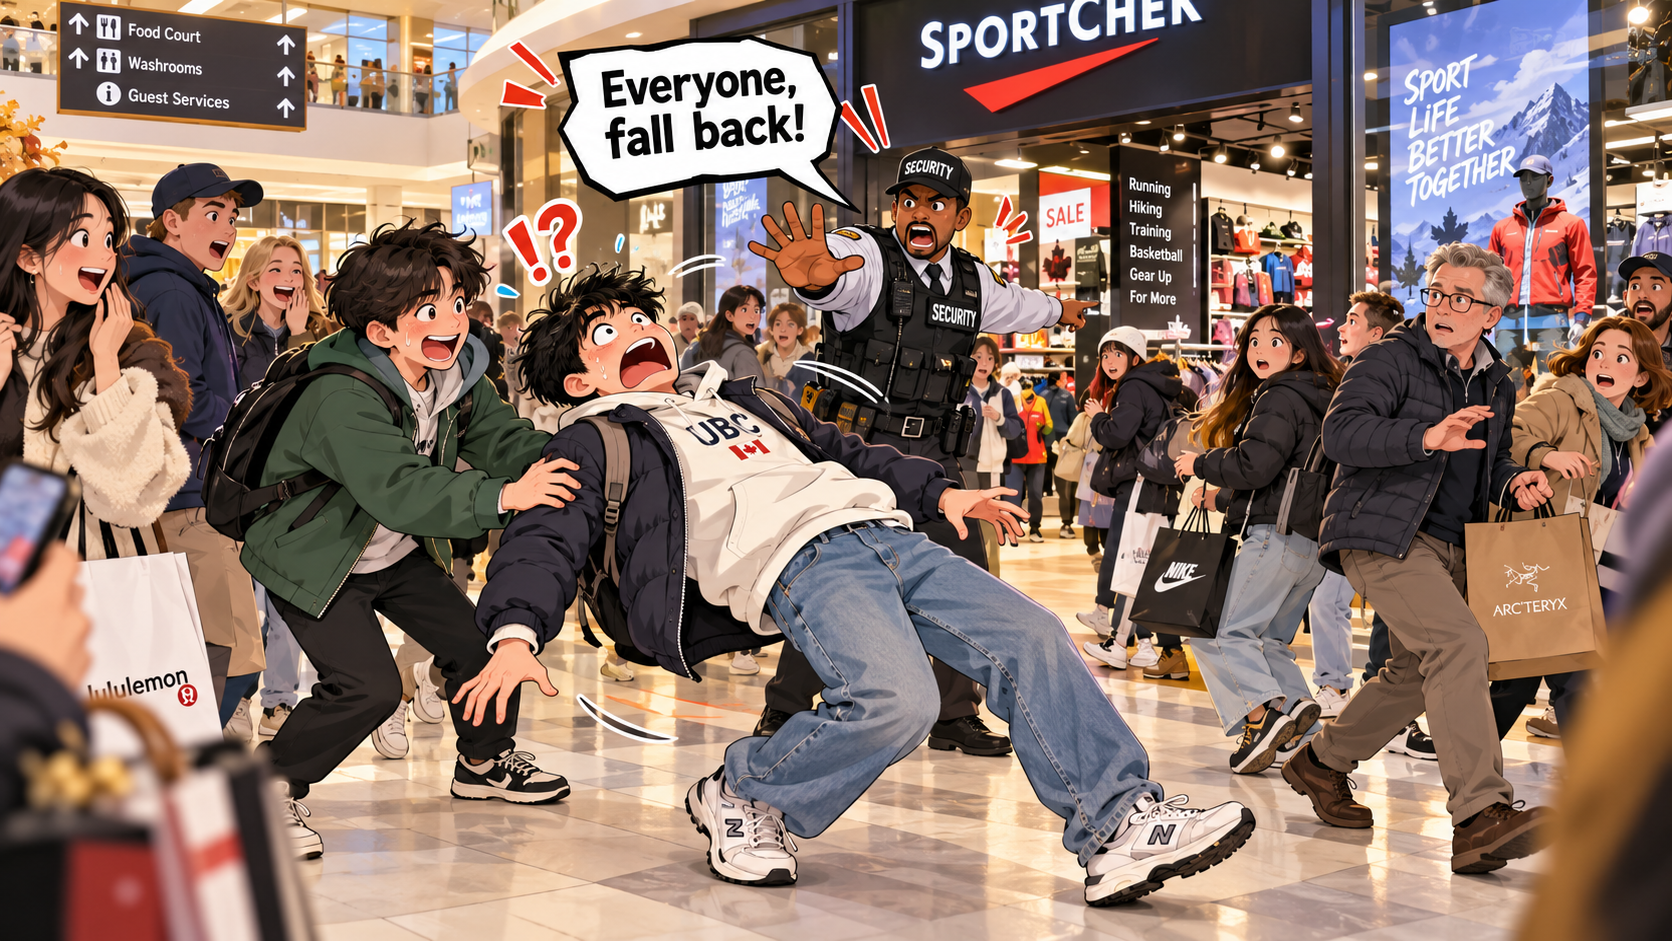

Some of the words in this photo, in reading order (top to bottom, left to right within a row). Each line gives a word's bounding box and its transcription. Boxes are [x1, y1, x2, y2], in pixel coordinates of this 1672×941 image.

[128, 23, 161, 39] Food
[164, 27, 201, 43] Court
[128, 56, 203, 75] Washrooms
[1404, 53, 1478, 105] SPORT
[128, 88, 169, 104] Guest
[172, 92, 230, 109] Services
[1407, 119, 1496, 174] BETTER
[904, 159, 954, 180] SECURITY
[1405, 146, 1517, 207] TOGETHER
[1129, 177, 1171, 198] Running
[1046, 202, 1085, 228] SALE
[1129, 199, 1163, 219] Hiking
[1129, 222, 1172, 242] Training
[1129, 244, 1183, 262] Basketball
[1129, 267, 1156, 281] Gear
[1158, 269, 1172, 286] Up
[1130, 289, 1148, 304] For
[1150, 291, 1177, 305] More
[931, 303, 977, 328] SECURITY
[685, 412, 761, 446] UBC
[1163, 561, 1199, 580] NIKE
[1493, 597, 1568, 617] ARC'TERYX
[1147, 824, 1177, 845] N
